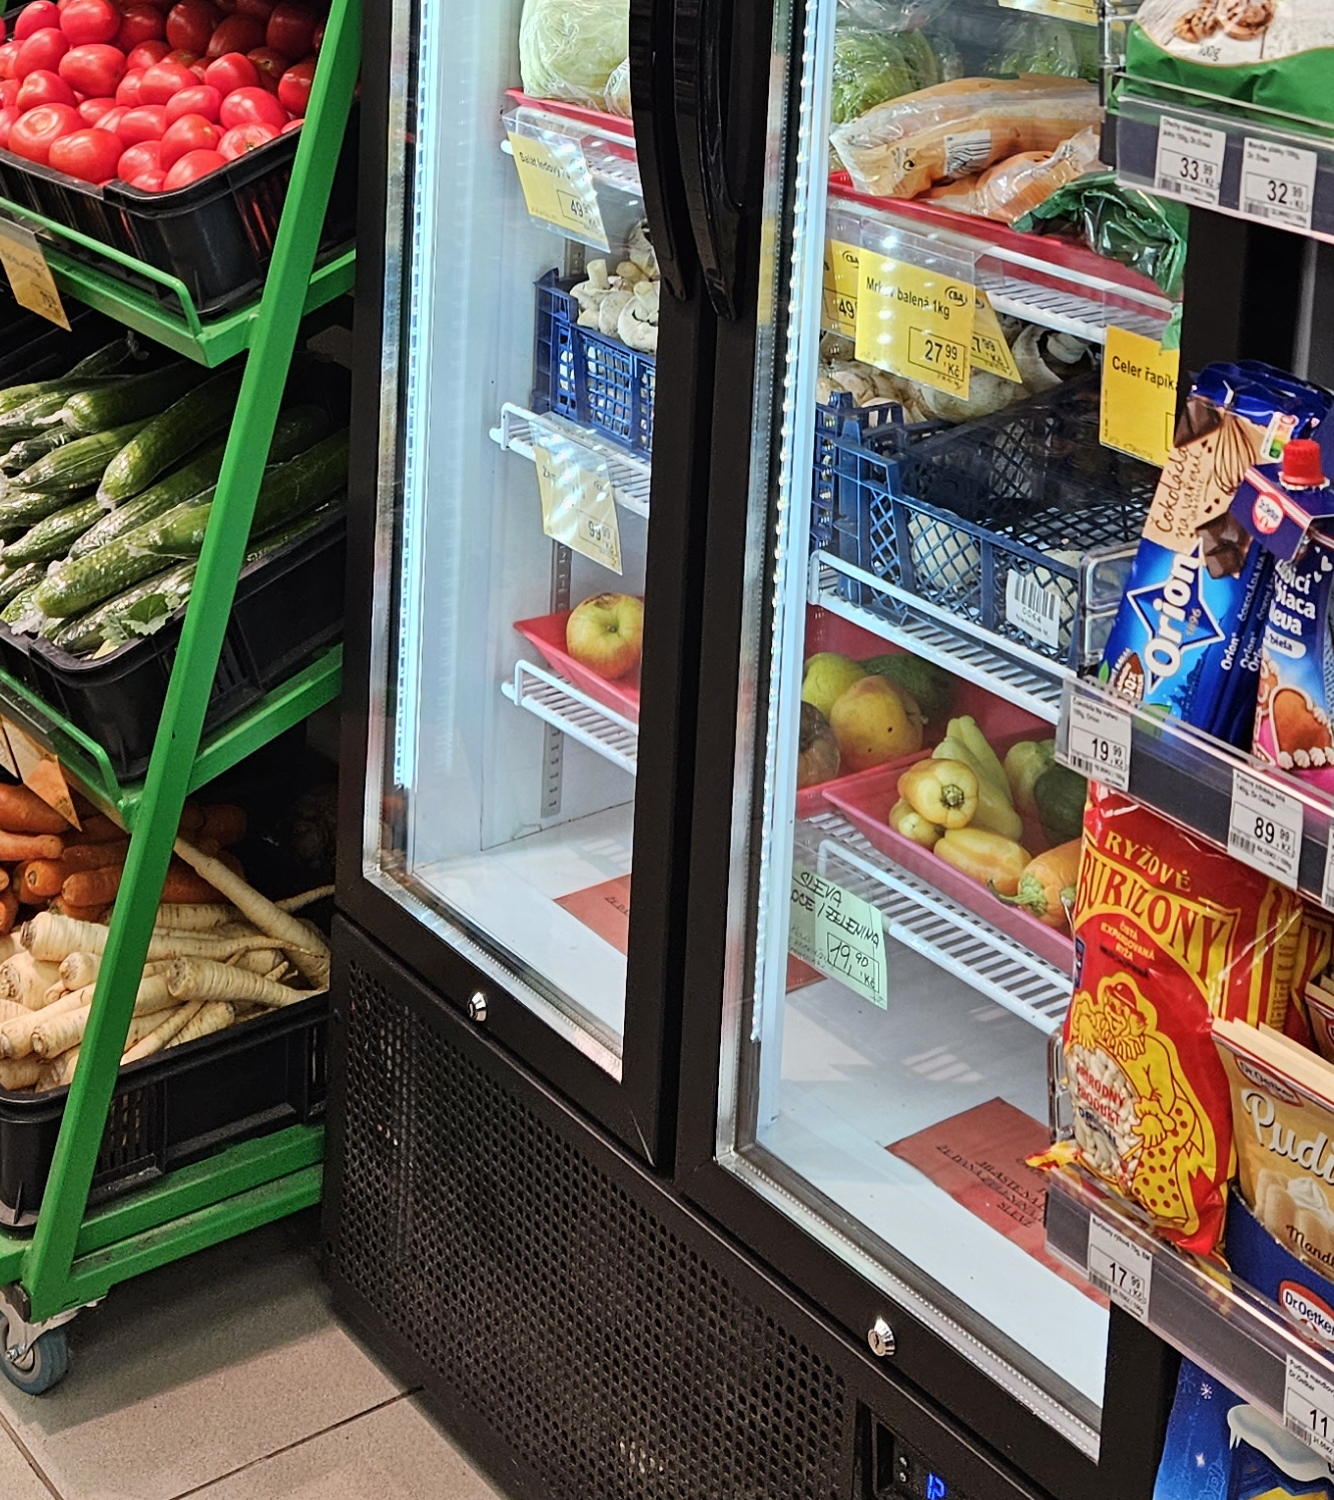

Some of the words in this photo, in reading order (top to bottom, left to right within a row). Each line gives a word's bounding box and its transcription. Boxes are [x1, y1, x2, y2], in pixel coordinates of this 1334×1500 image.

[1111, 355, 1143, 382] Celer
[1144, 550, 1200, 679] Orion
[800, 871, 843, 908] SLEVA
[1104, 829, 1192, 893] RYŽOVÉ
[1076, 849, 1230, 982] BURIZONY
